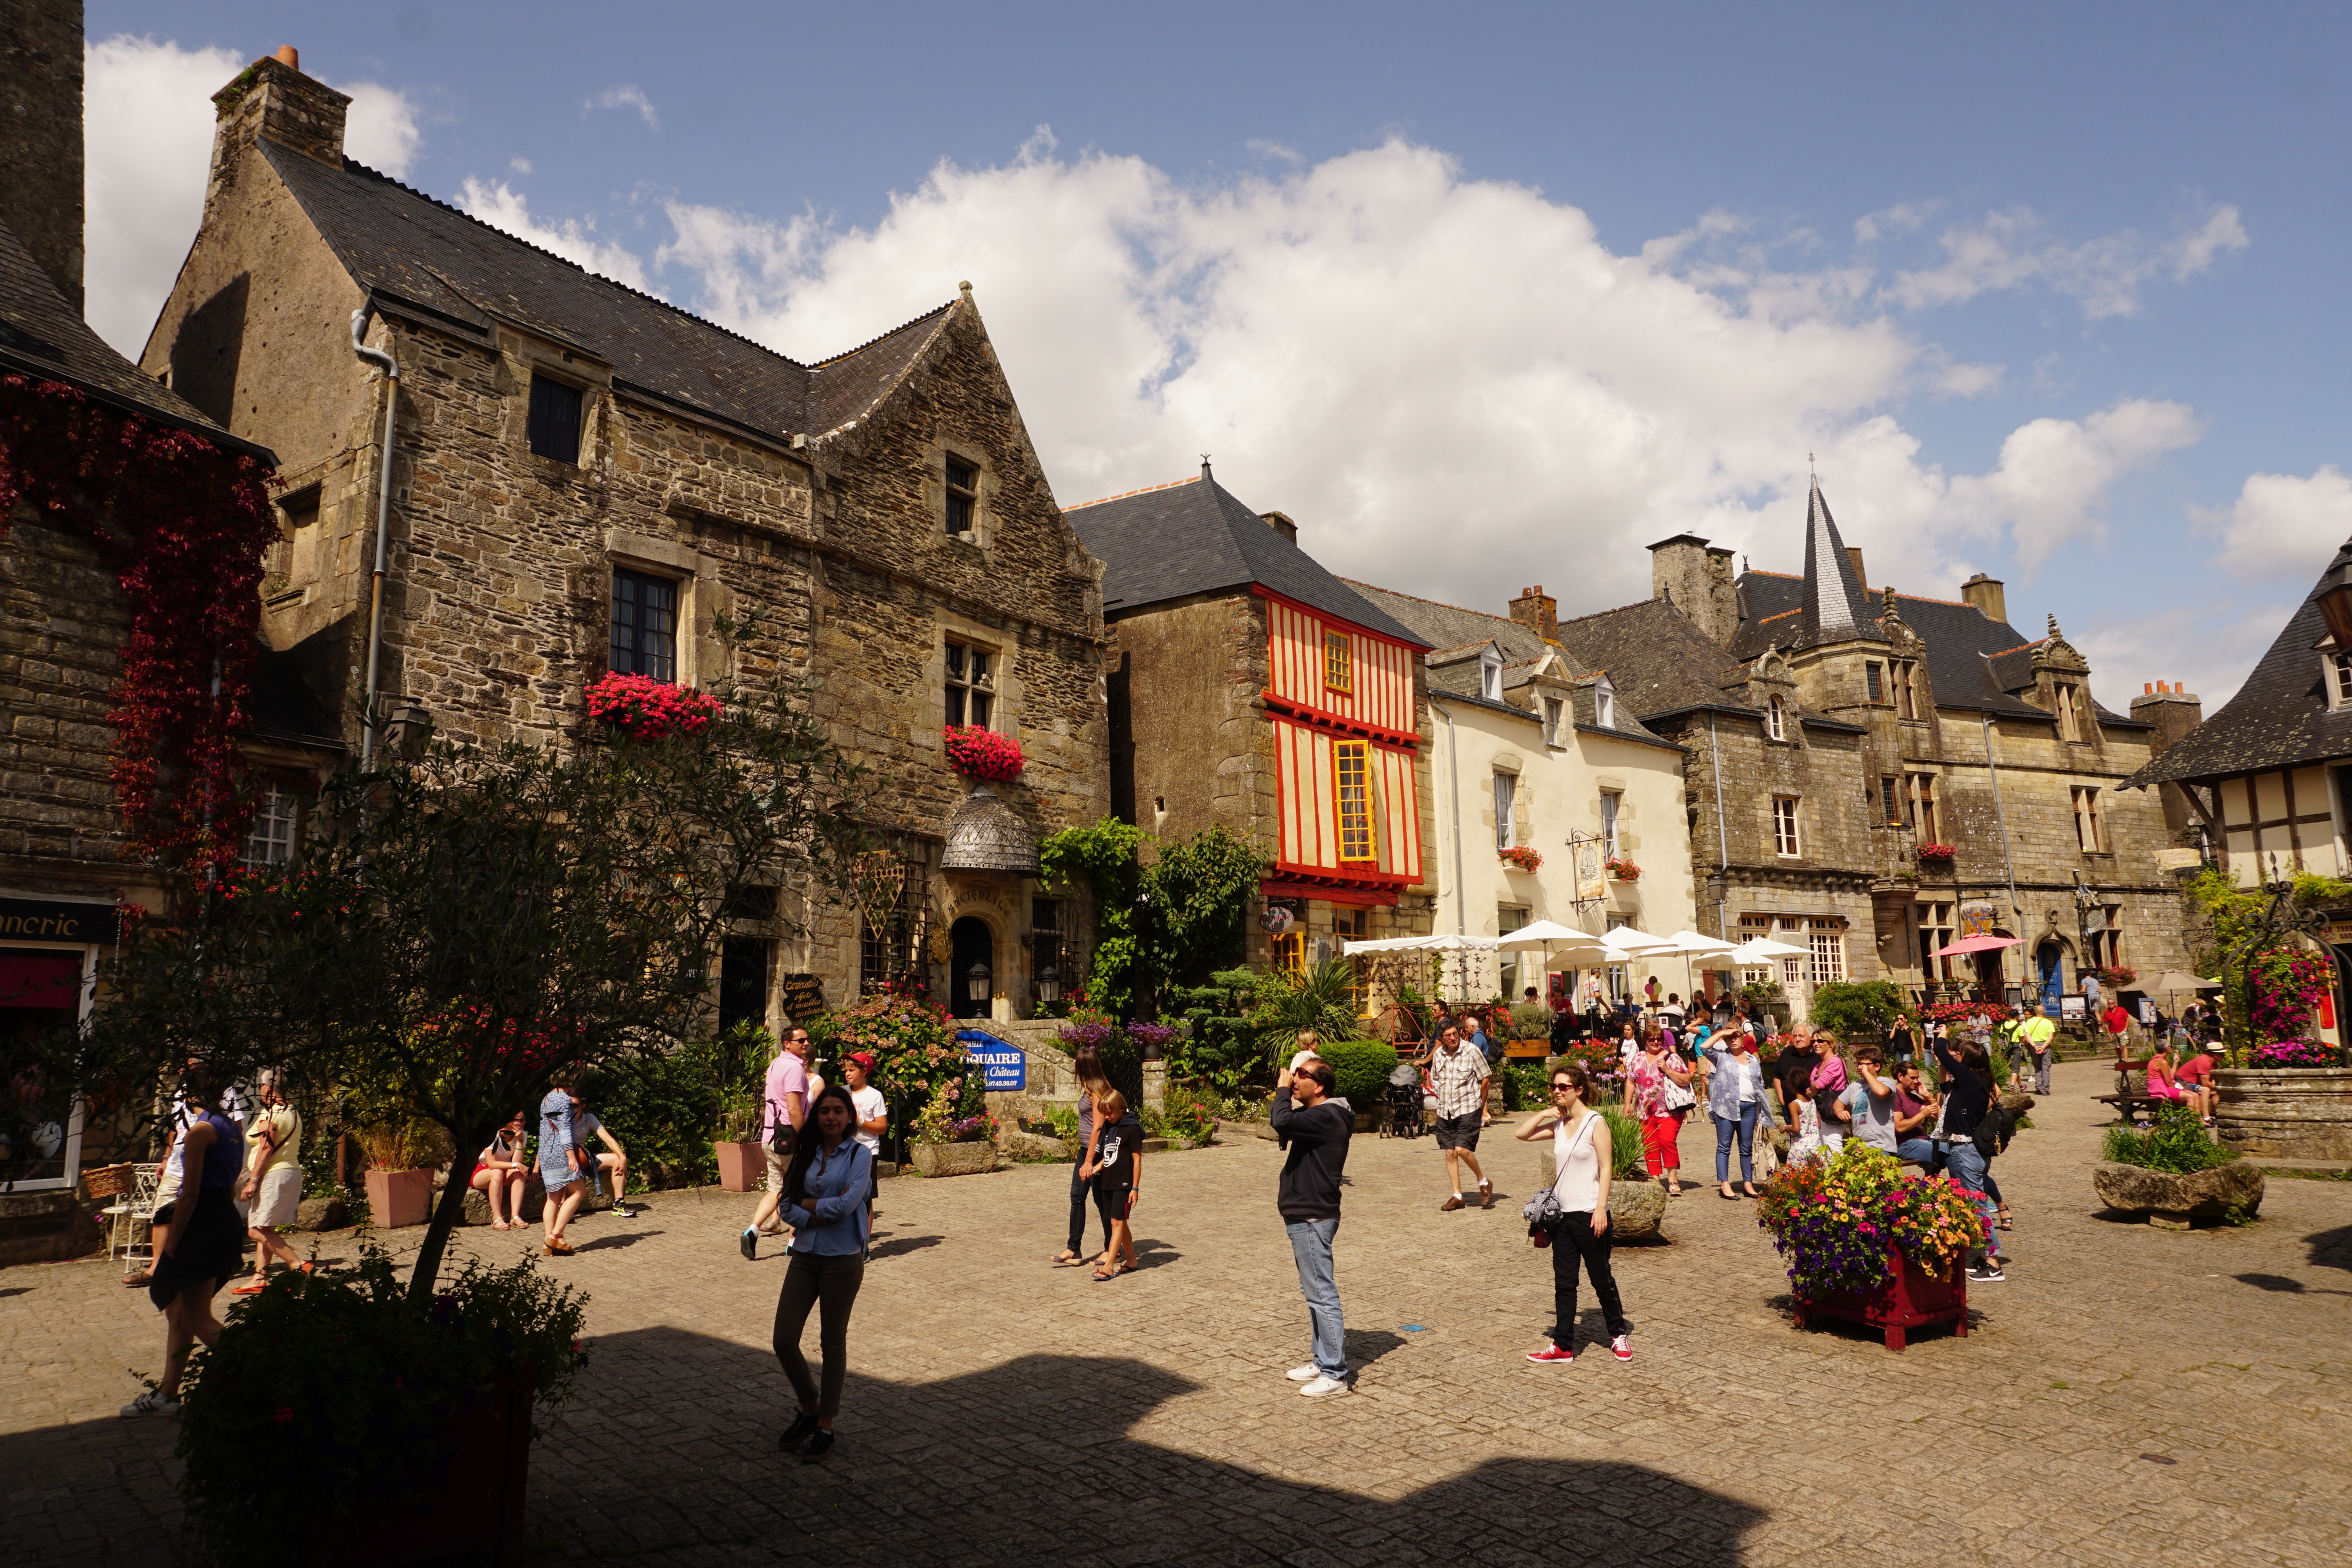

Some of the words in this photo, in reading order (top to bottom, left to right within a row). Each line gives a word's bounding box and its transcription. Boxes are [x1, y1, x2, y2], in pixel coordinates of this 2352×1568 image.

[0, 913, 79, 936] nerie
[795, 997, 821, 1009] meubles
[795, 1007, 820, 1018] anciens
[990, 1066, 1020, 1077] Château
